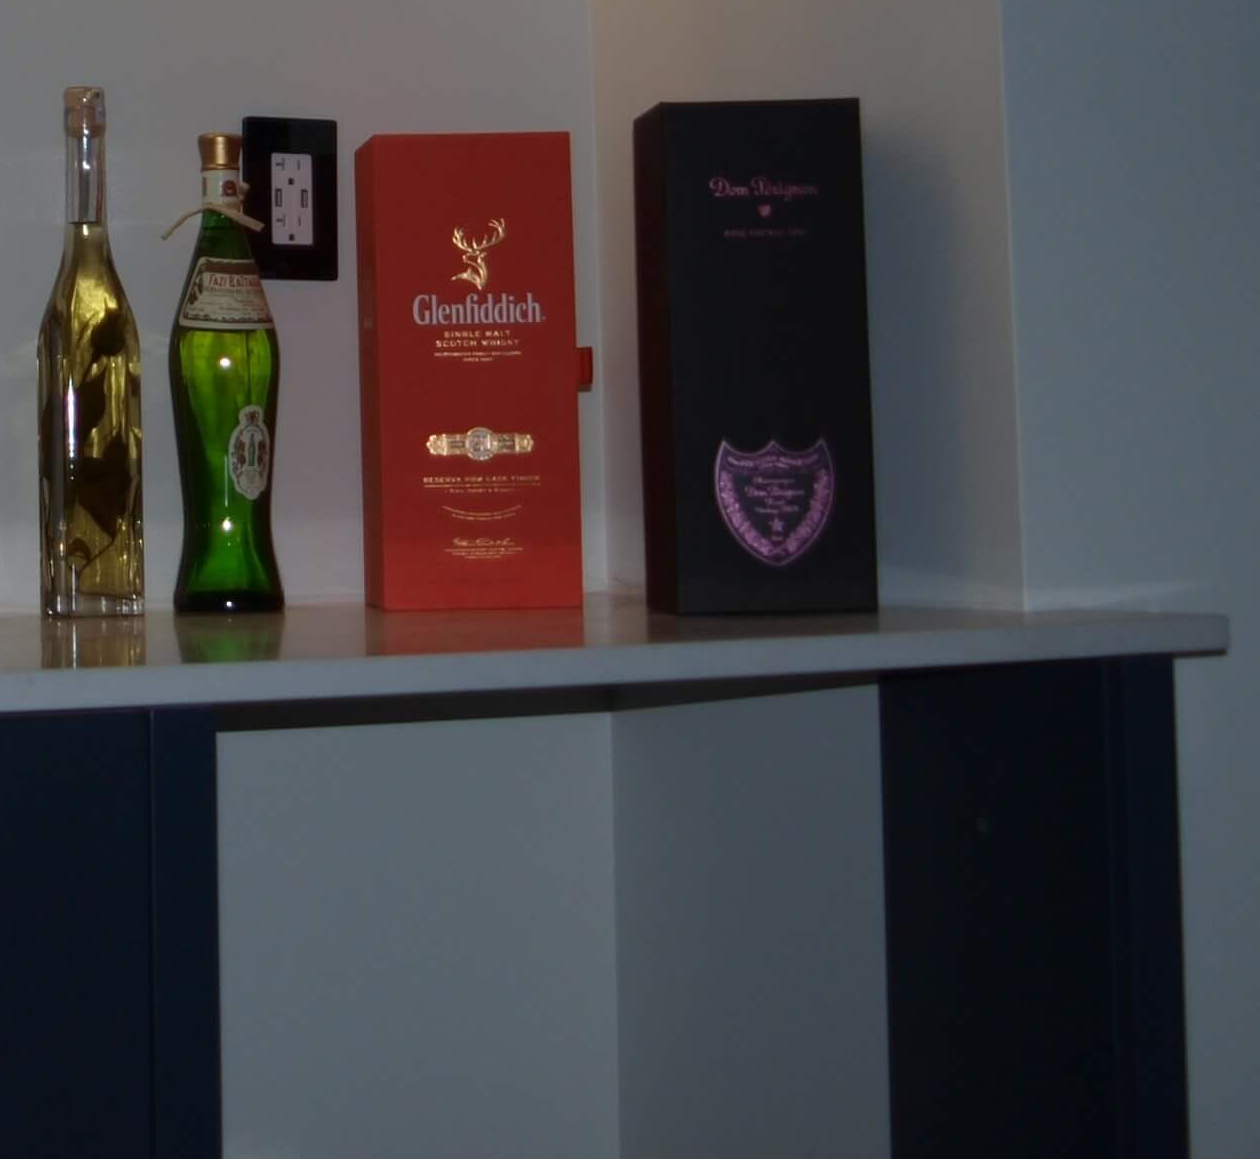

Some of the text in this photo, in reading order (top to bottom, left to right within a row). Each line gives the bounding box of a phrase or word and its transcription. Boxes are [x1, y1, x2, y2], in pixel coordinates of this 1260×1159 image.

[708, 176, 749, 198] Dom
[412, 292, 542, 326] Glenfiddich
[443, 330, 511, 338] SINGLE MALT
[435, 338, 520, 347] SCOTCH WHISKY
